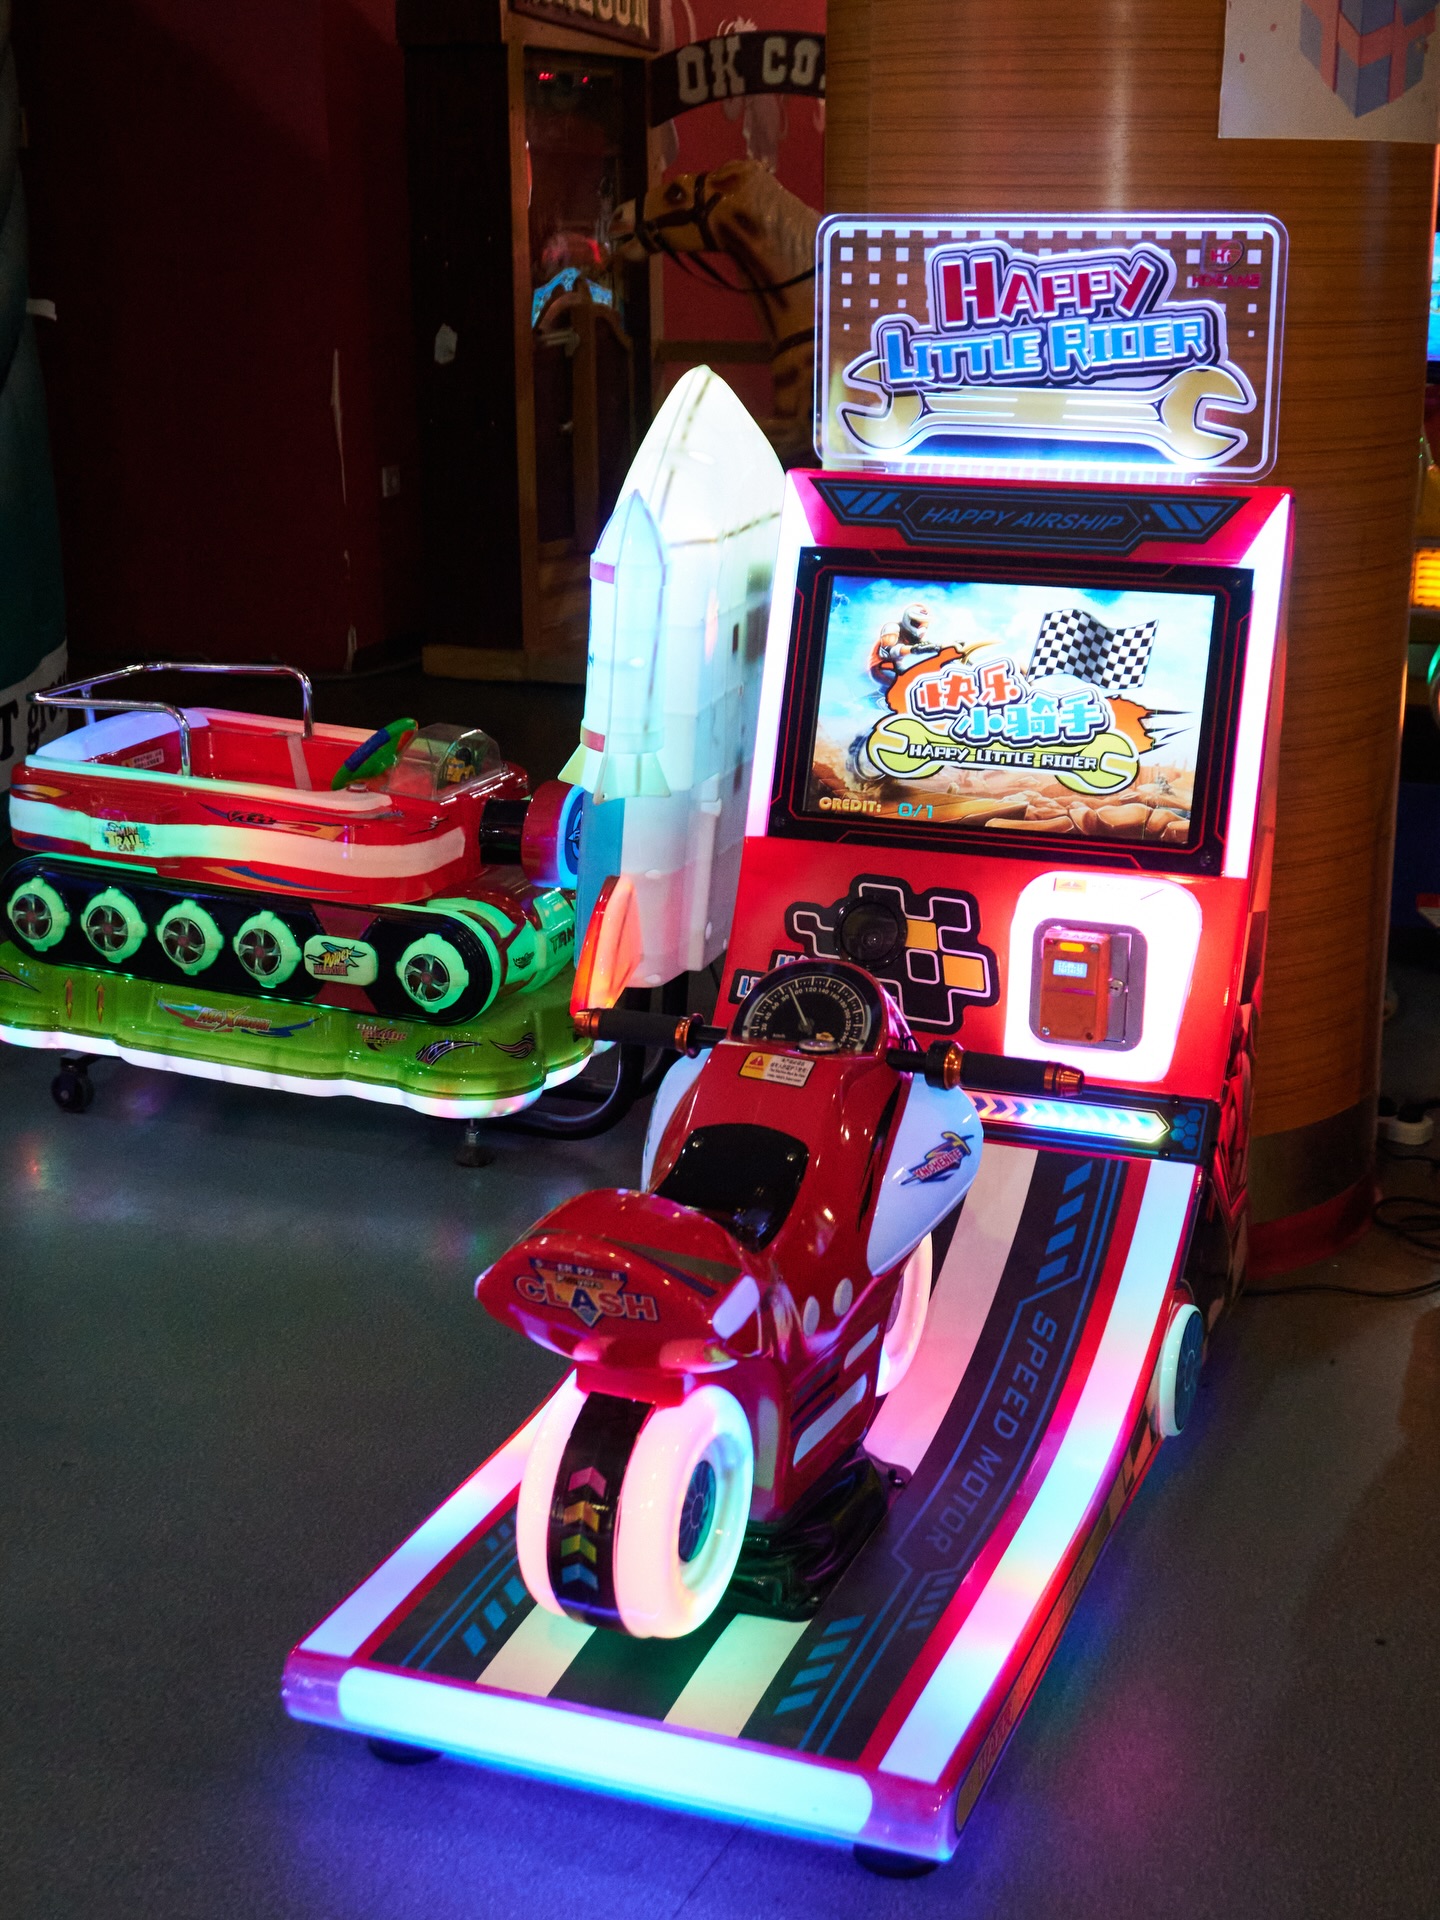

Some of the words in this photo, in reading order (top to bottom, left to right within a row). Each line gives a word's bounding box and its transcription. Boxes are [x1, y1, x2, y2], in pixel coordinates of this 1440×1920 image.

[677, 37, 745, 104] OK
[936, 257, 1158, 327] HAPPY
[882, 328, 1043, 384] LITTLE
[1048, 314, 1208, 373] RIDER
[919, 506, 1017, 529] HAPPY
[1014, 511, 1126, 531] AIRSHIP
[917, 662, 1021, 712] 快乐
[957, 690, 1104, 741] 小骑手
[908, 742, 970, 763] HAPPY
[976, 748, 1035, 767] LITTLE
[1041, 752, 1098, 771] RIDER
[819, 796, 882, 813] CREDIT:
[898, 802, 934, 819] 0/1
[818, 987, 830, 995] 140
[515, 1275, 659, 1322] CLASH
[992, 1310, 1058, 1440] SPEED
[925, 1444, 1001, 1553] MOTOR
